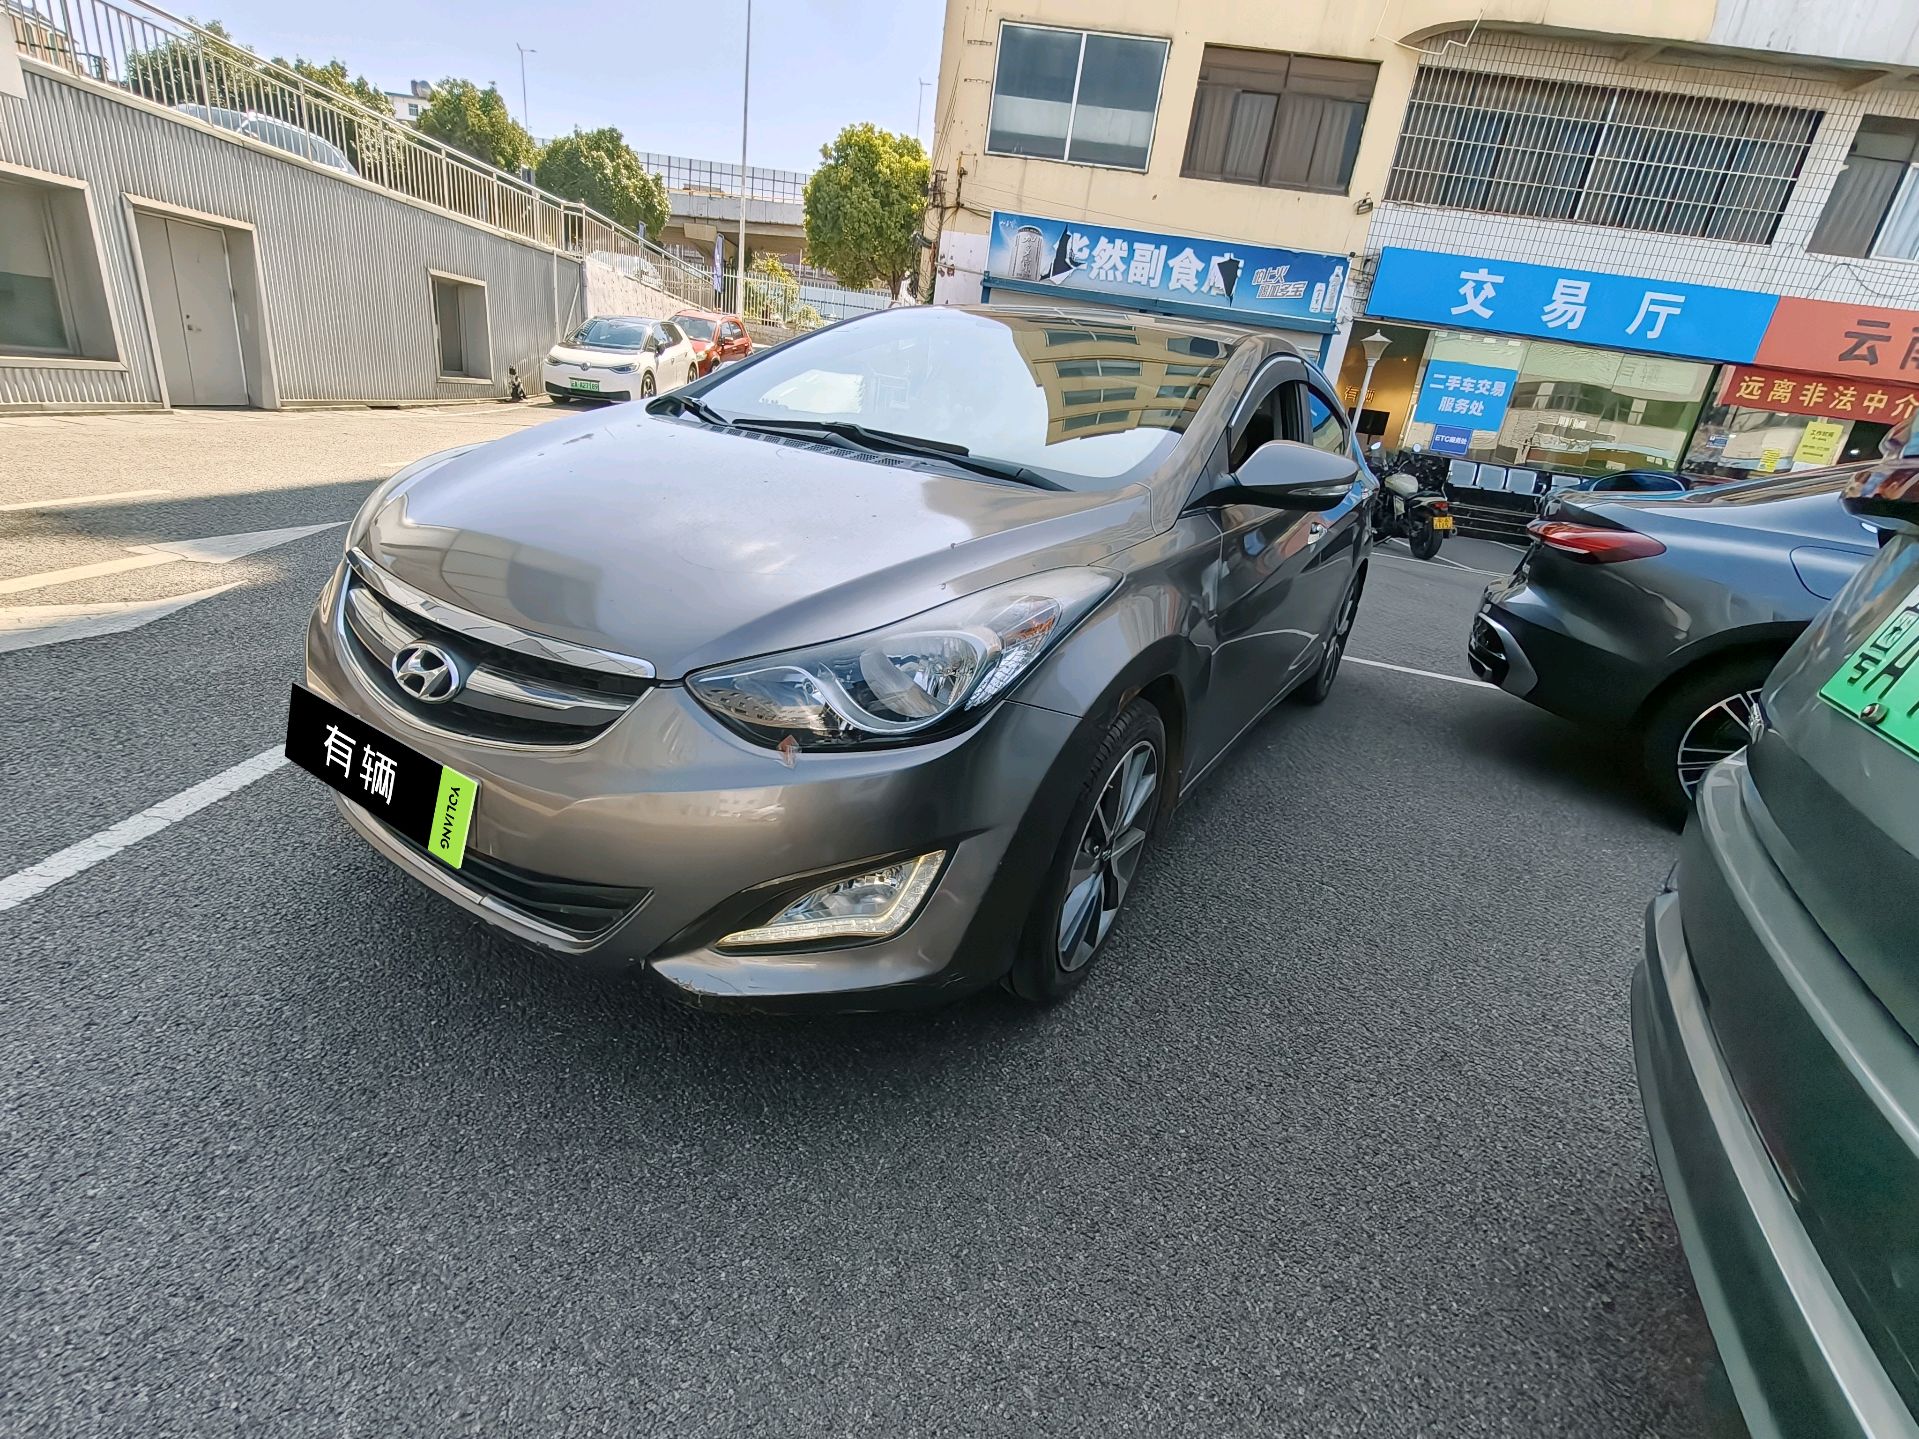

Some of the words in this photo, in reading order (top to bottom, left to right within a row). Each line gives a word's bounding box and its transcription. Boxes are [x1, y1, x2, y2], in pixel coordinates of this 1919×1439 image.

[1450, 268, 1686, 339] 交易厅
[1430, 373, 1507, 397] 二手车交易
[1735, 375, 1919, 419] 远离非法中介
[1438, 396, 1485, 416] 服务处
